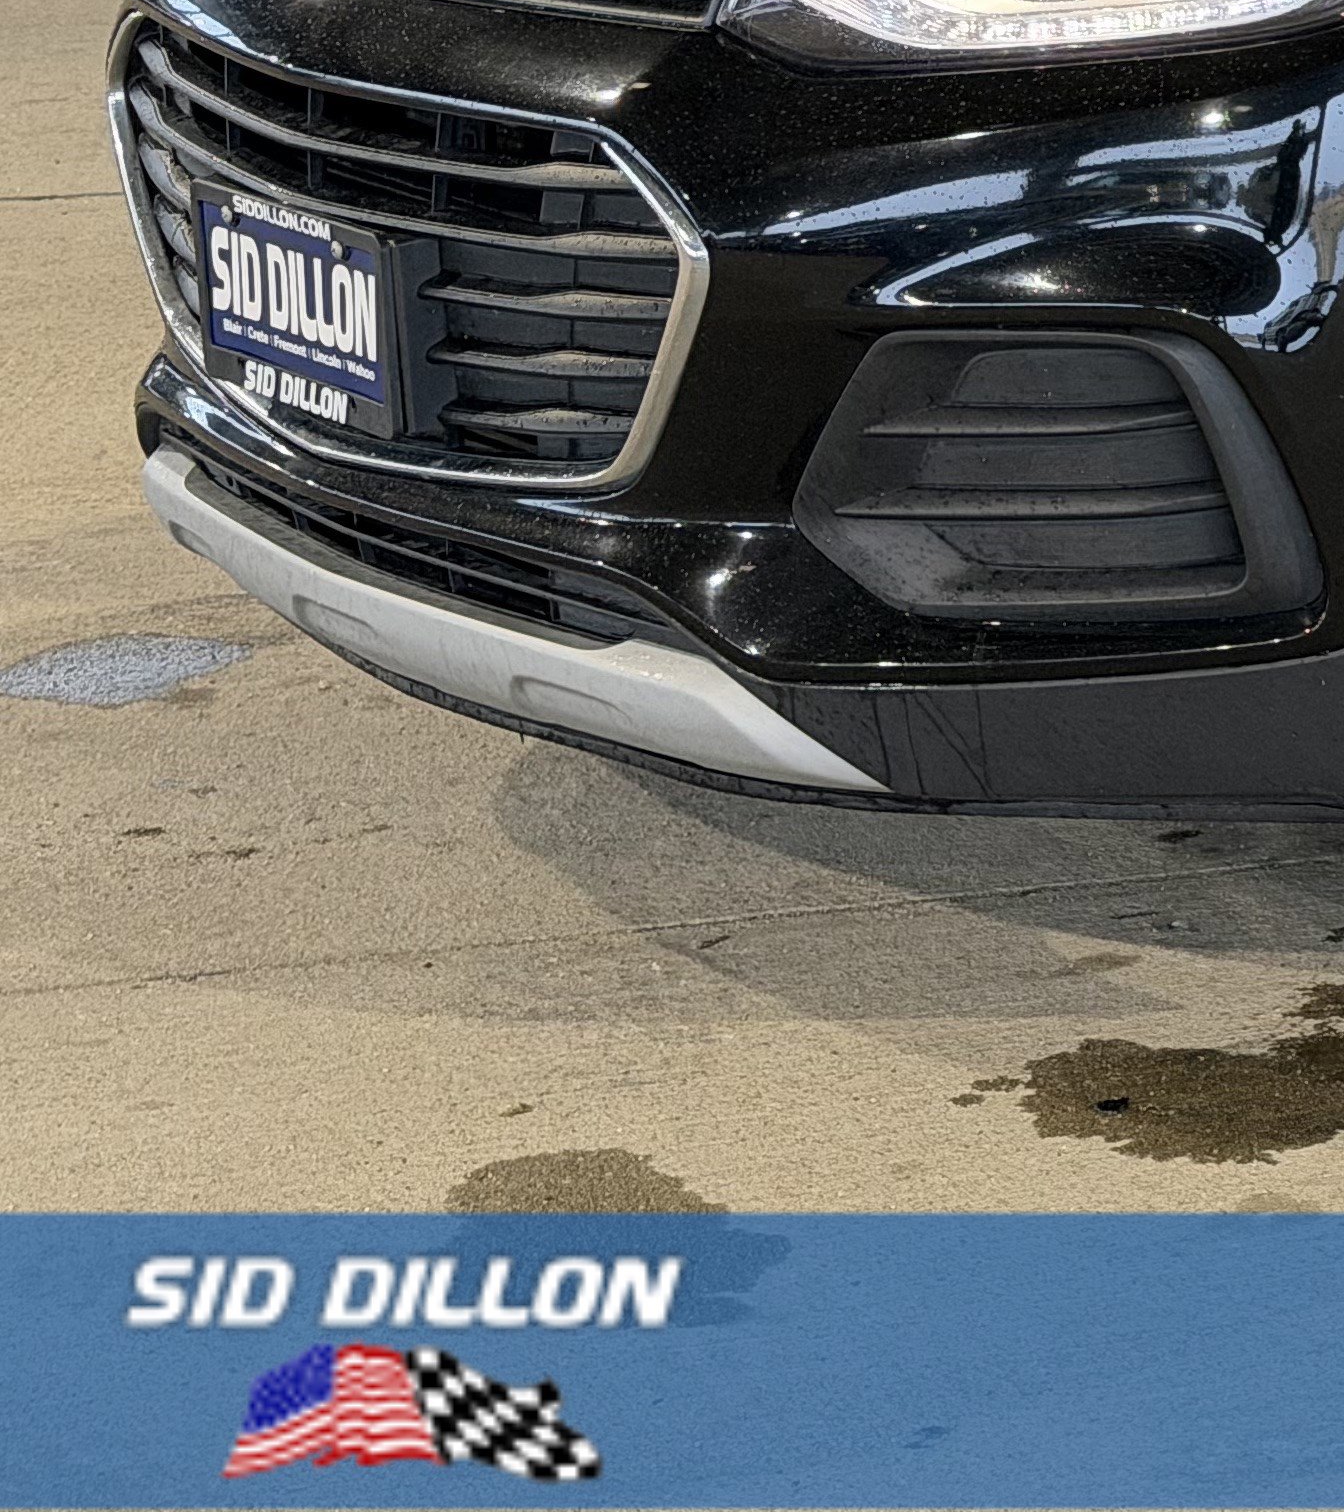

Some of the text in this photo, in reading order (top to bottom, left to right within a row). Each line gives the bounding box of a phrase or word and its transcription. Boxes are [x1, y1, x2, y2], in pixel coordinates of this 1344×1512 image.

[232, 194, 332, 241] SIDDILLON.COM
[211, 225, 377, 363] SID DILLON
[222, 317, 377, 382] Blair Crete Fremont Lincoln Wahoo
[243, 359, 348, 425] SID DILLON
